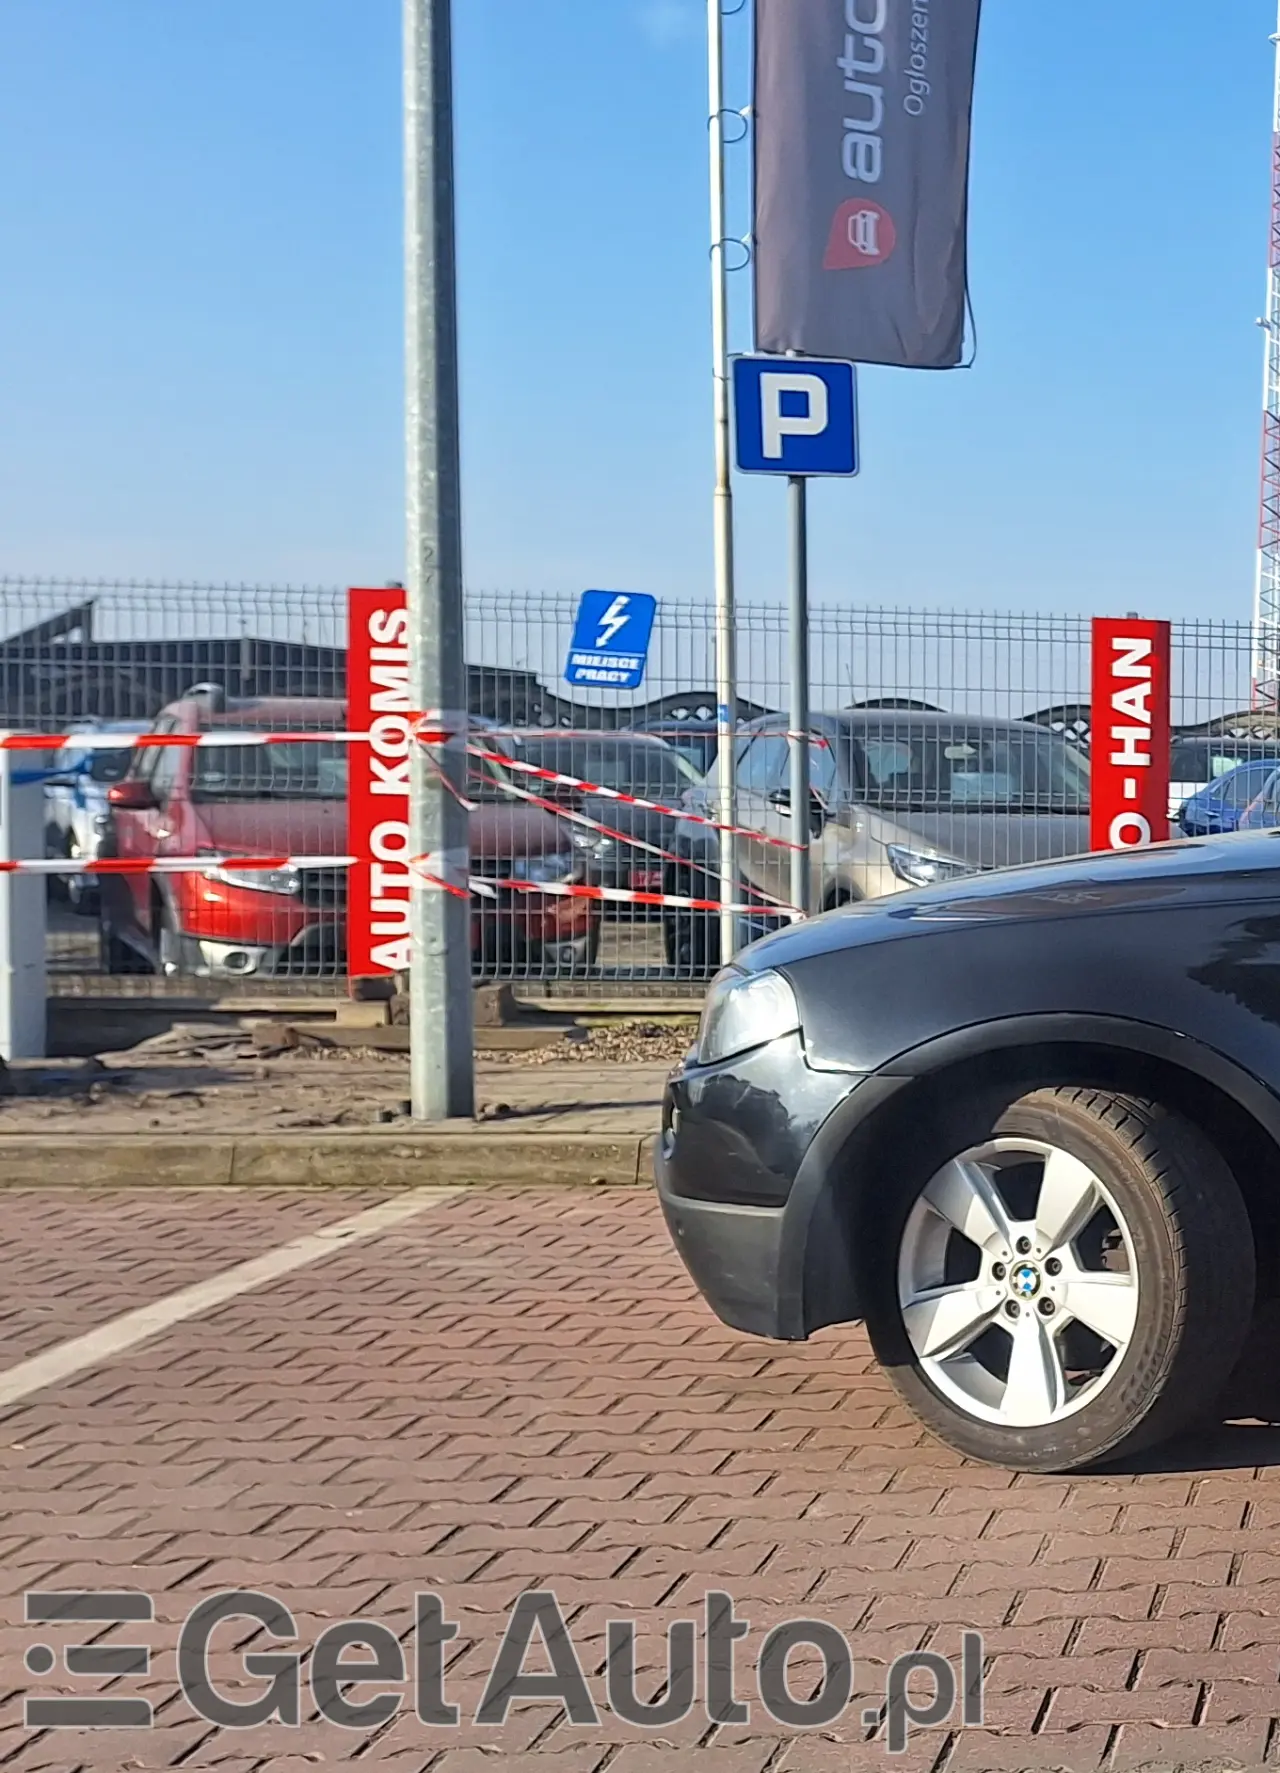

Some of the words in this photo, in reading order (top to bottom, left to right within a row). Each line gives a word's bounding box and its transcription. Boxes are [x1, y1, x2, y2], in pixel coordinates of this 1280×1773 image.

[760, 372, 828, 459] P
[368, 608, 410, 796] KOMIS
[570, 653, 640, 669] MIEJSCE
[574, 667, 631, 682] PRACY
[369, 820, 411, 971] AUTO
